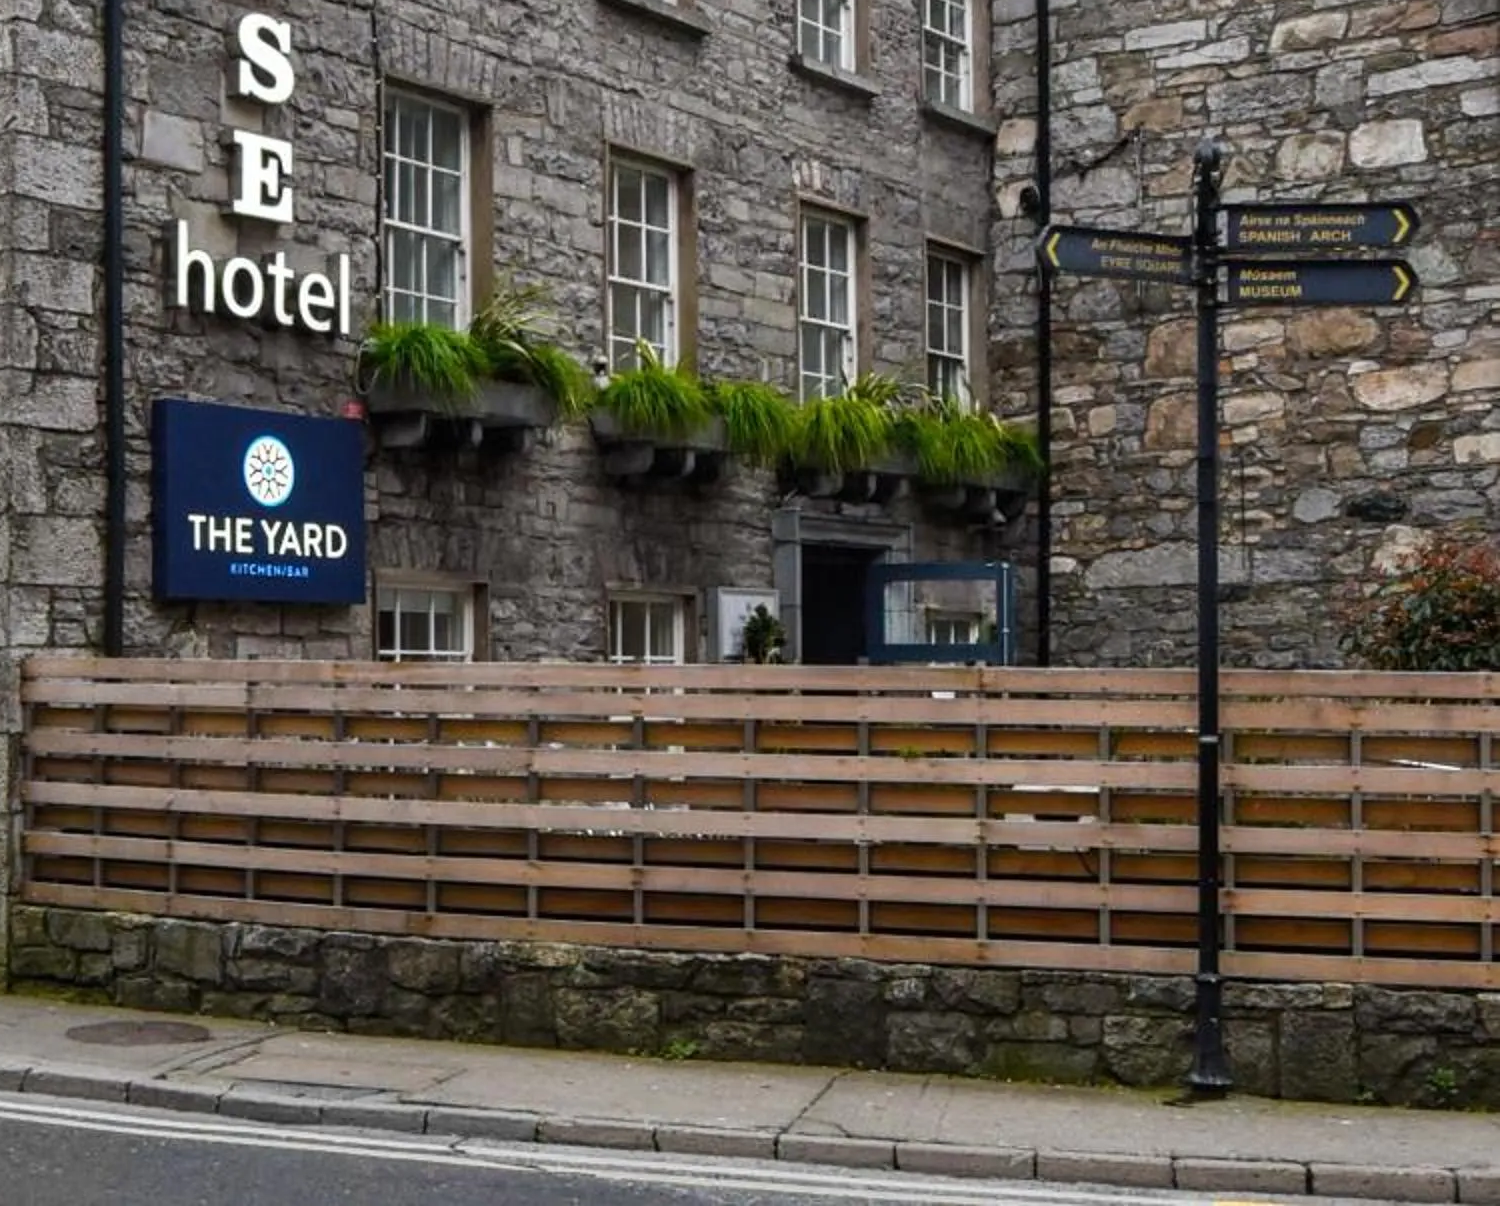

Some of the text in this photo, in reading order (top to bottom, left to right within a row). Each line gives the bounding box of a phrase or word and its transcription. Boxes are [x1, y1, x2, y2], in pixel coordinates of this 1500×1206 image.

[1239, 229, 1351, 242] SPANISH ARCH
[177, 219, 350, 335] hotel
[1240, 285, 1302, 298] MUSEUM
[187, 514, 348, 559] THE YARD
